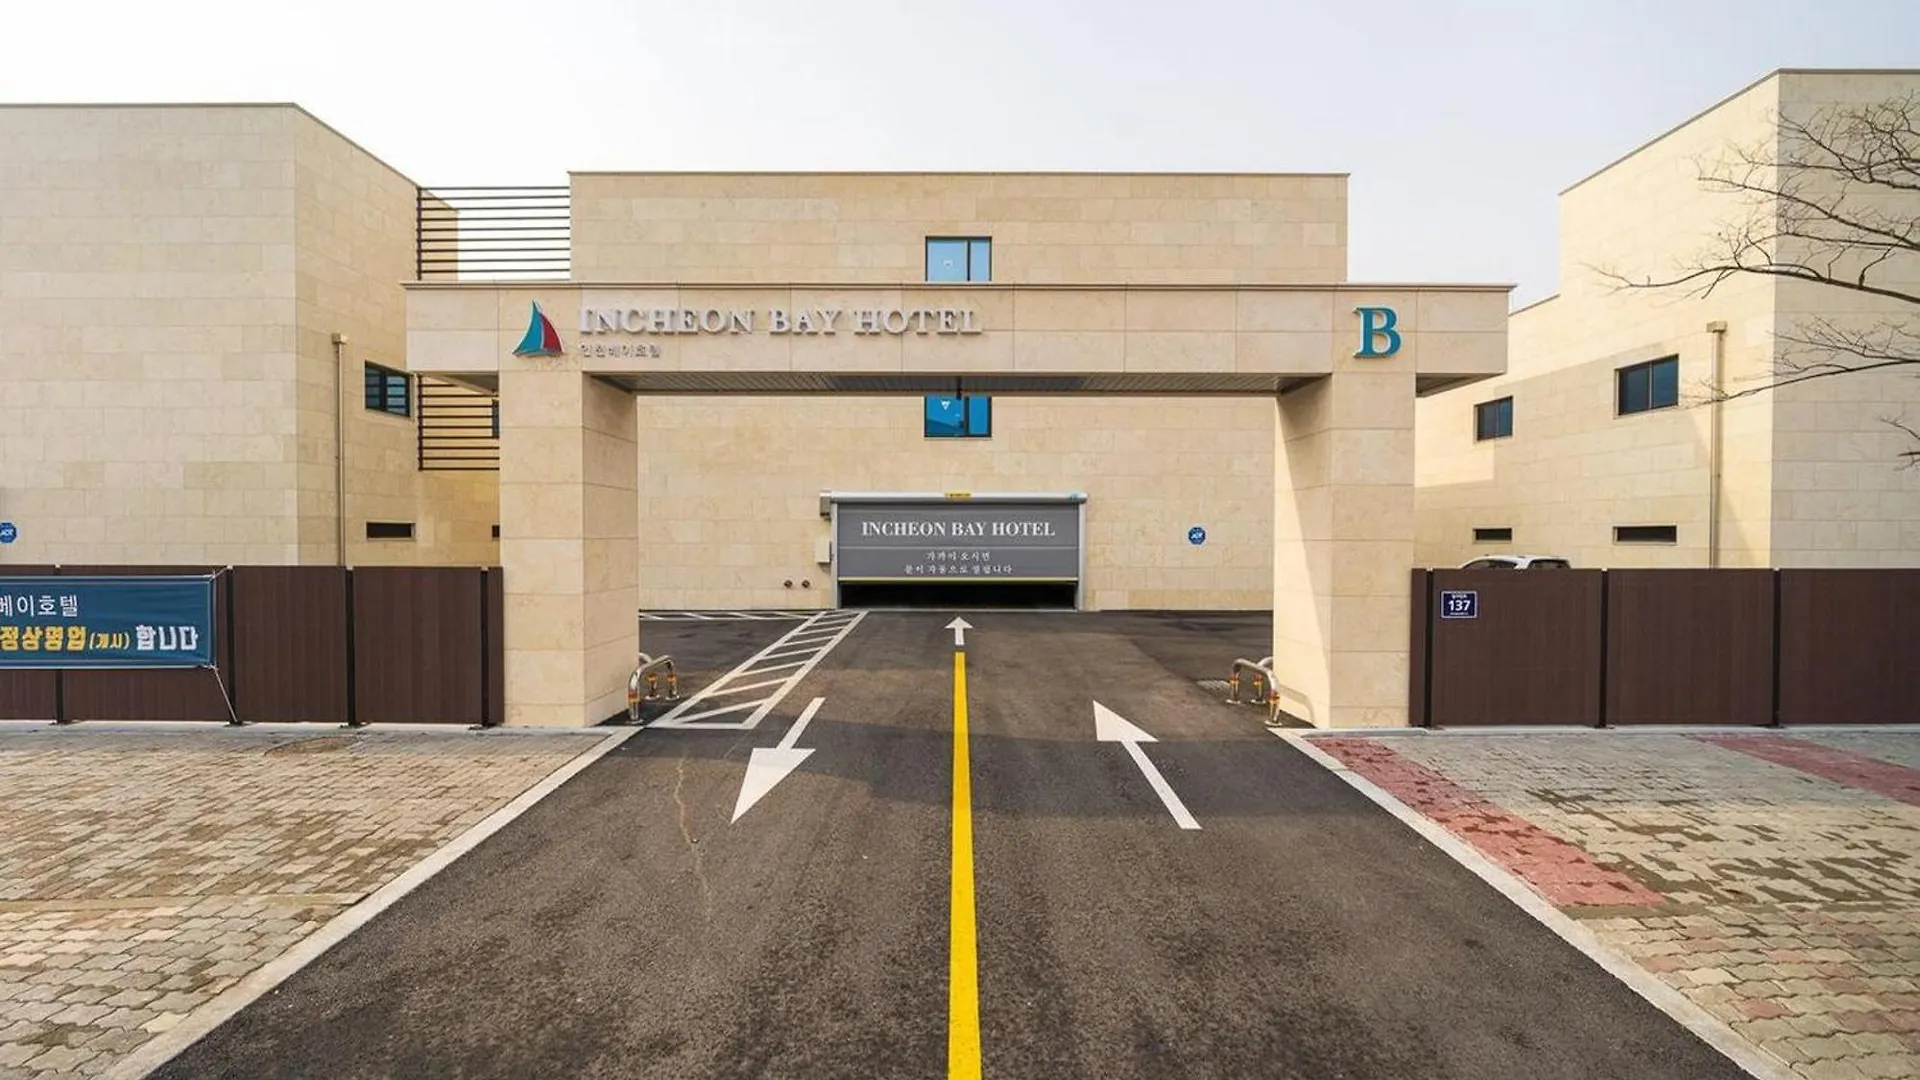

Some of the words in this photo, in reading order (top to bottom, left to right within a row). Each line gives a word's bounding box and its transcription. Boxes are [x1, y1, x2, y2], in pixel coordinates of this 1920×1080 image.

[579, 307, 756, 335] INCHEON
[769, 308, 845, 335] BAY
[853, 308, 983, 336] HOTEL
[1352, 304, 1402, 359] B
[861, 521, 947, 537] INCHEON
[951, 521, 988, 537] BAY
[991, 521, 1056, 537] HOTEL
[1448, 599, 1471, 611] 137
[135, 624, 199, 650] 합니다
